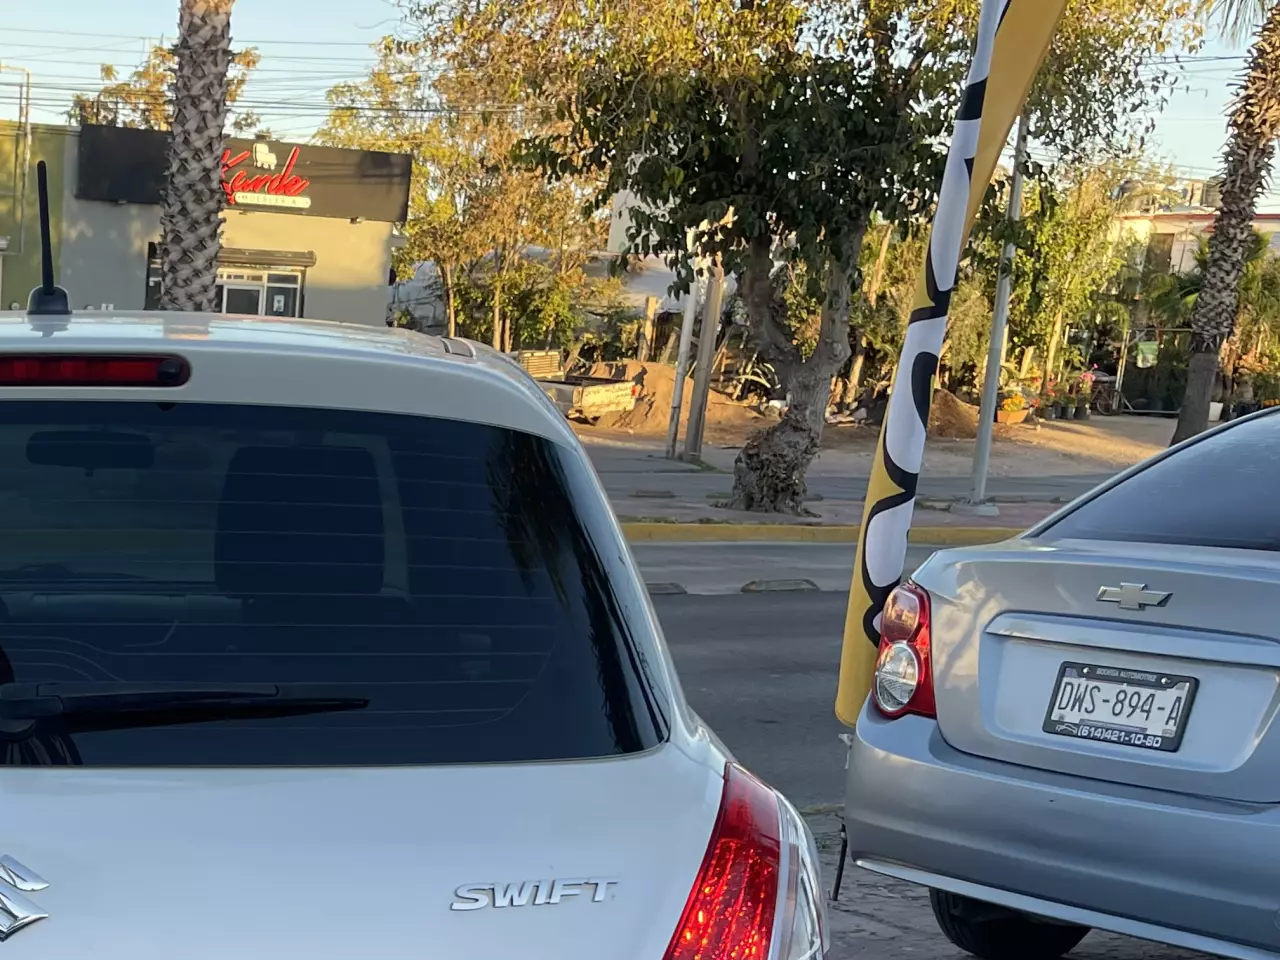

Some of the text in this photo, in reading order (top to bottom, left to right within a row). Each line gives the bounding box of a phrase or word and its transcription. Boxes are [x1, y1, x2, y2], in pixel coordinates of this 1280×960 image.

[1057, 682, 1183, 727] DWS-894-A
[1078, 725, 1162, 748] (614)421-10-80
[450, 876, 619, 911] SWIFT
